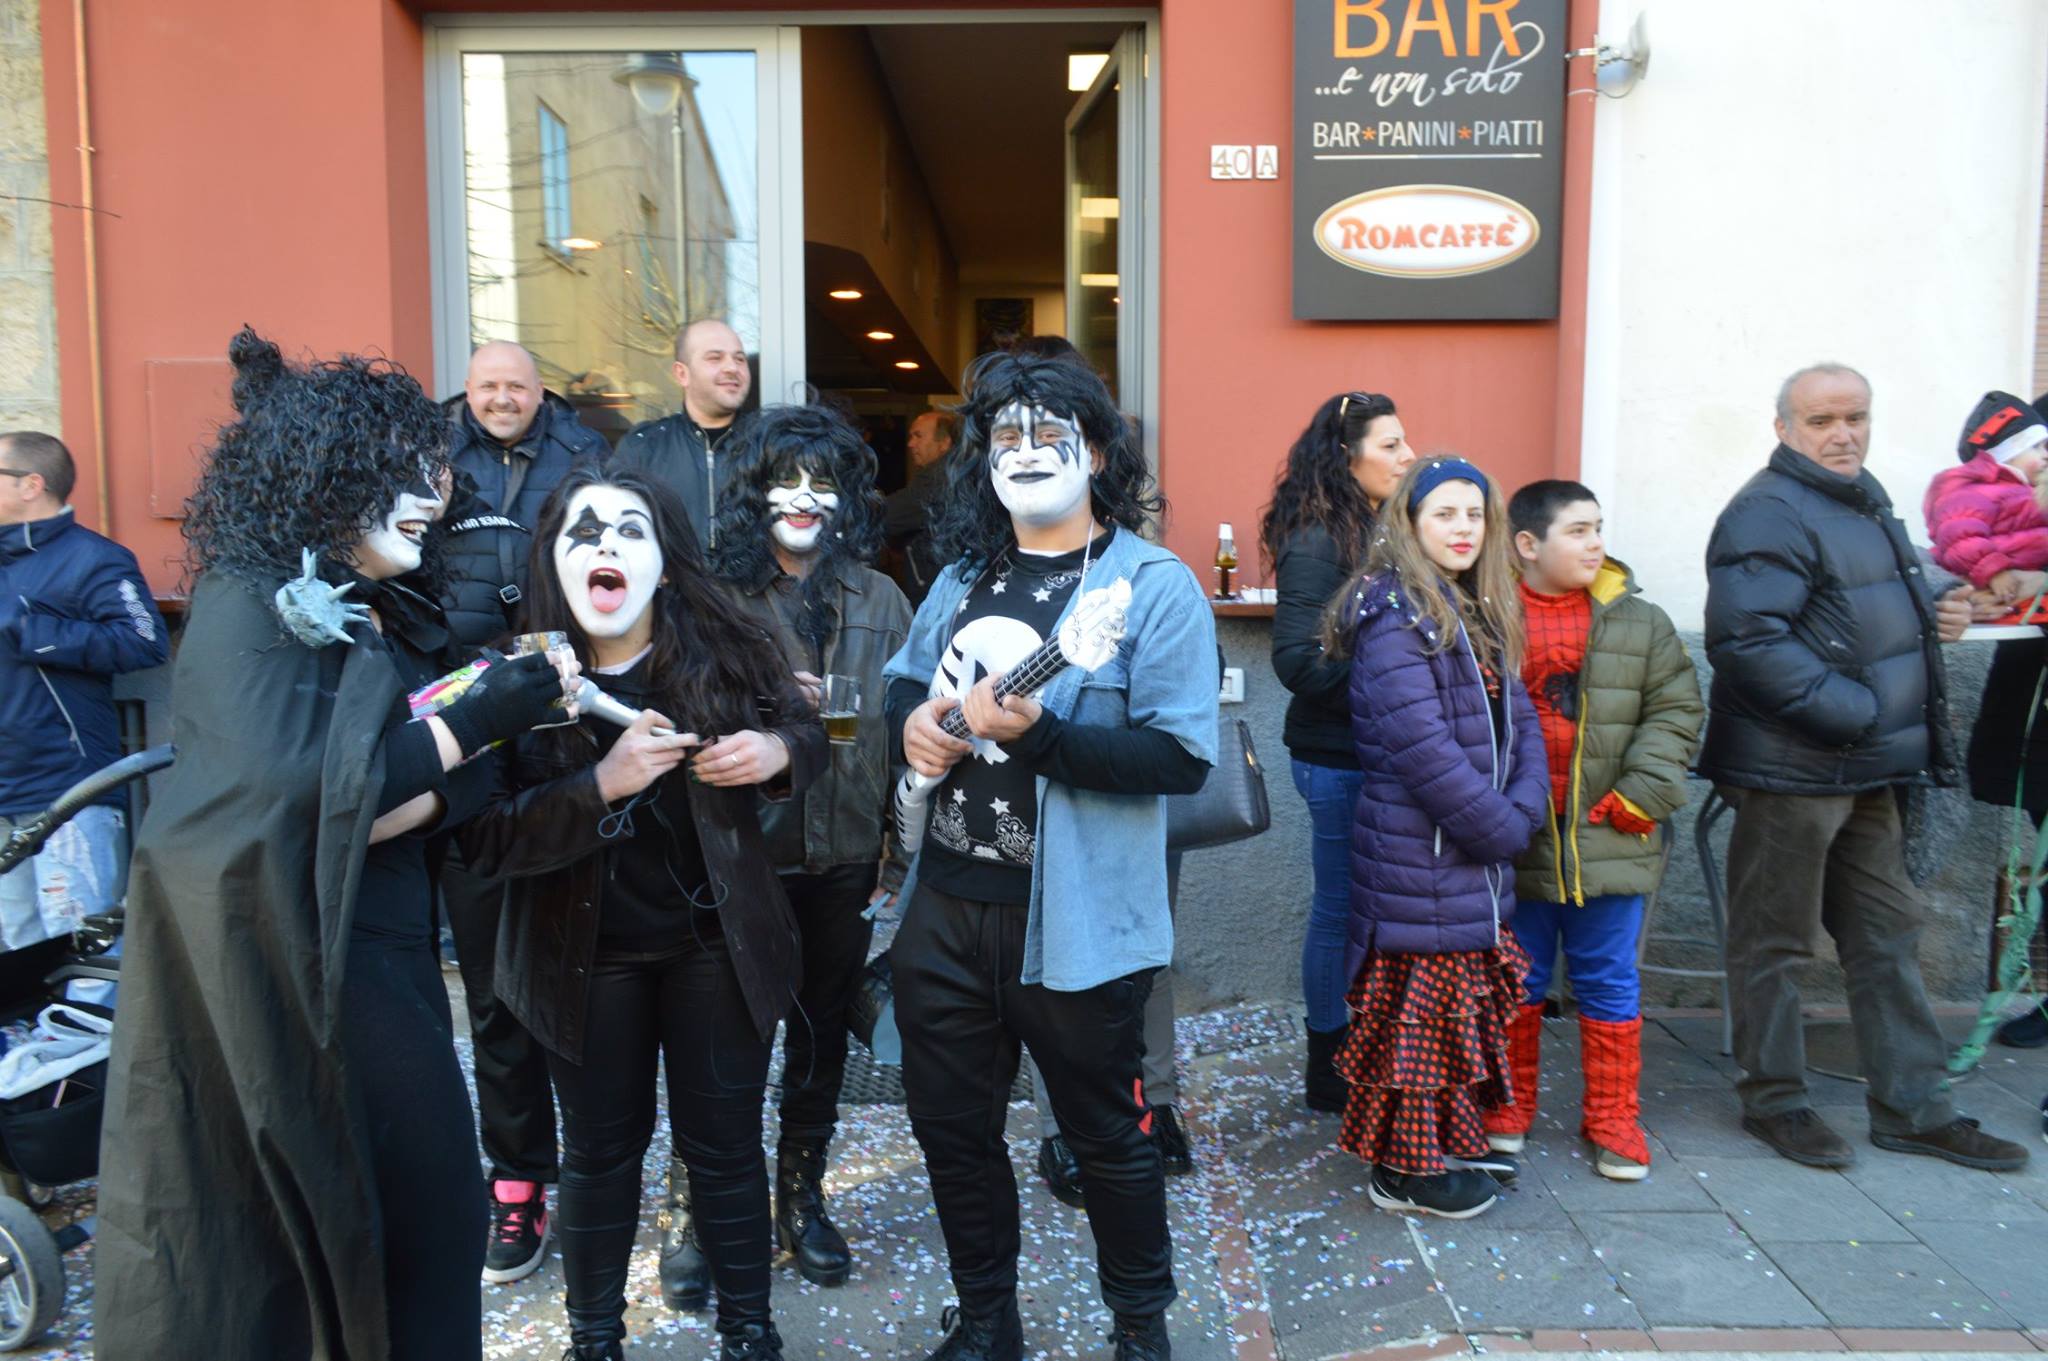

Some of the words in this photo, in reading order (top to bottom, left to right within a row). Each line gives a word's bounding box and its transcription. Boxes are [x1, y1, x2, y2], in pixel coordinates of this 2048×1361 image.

[1333, 0, 1522, 58] BAR
[1368, 71, 1437, 107] non
[1441, 21, 1546, 96] solo
[1313, 121, 1361, 148] BAR
[1377, 120, 1456, 148] PANINI
[1474, 119, 1544, 147] PIATTI
